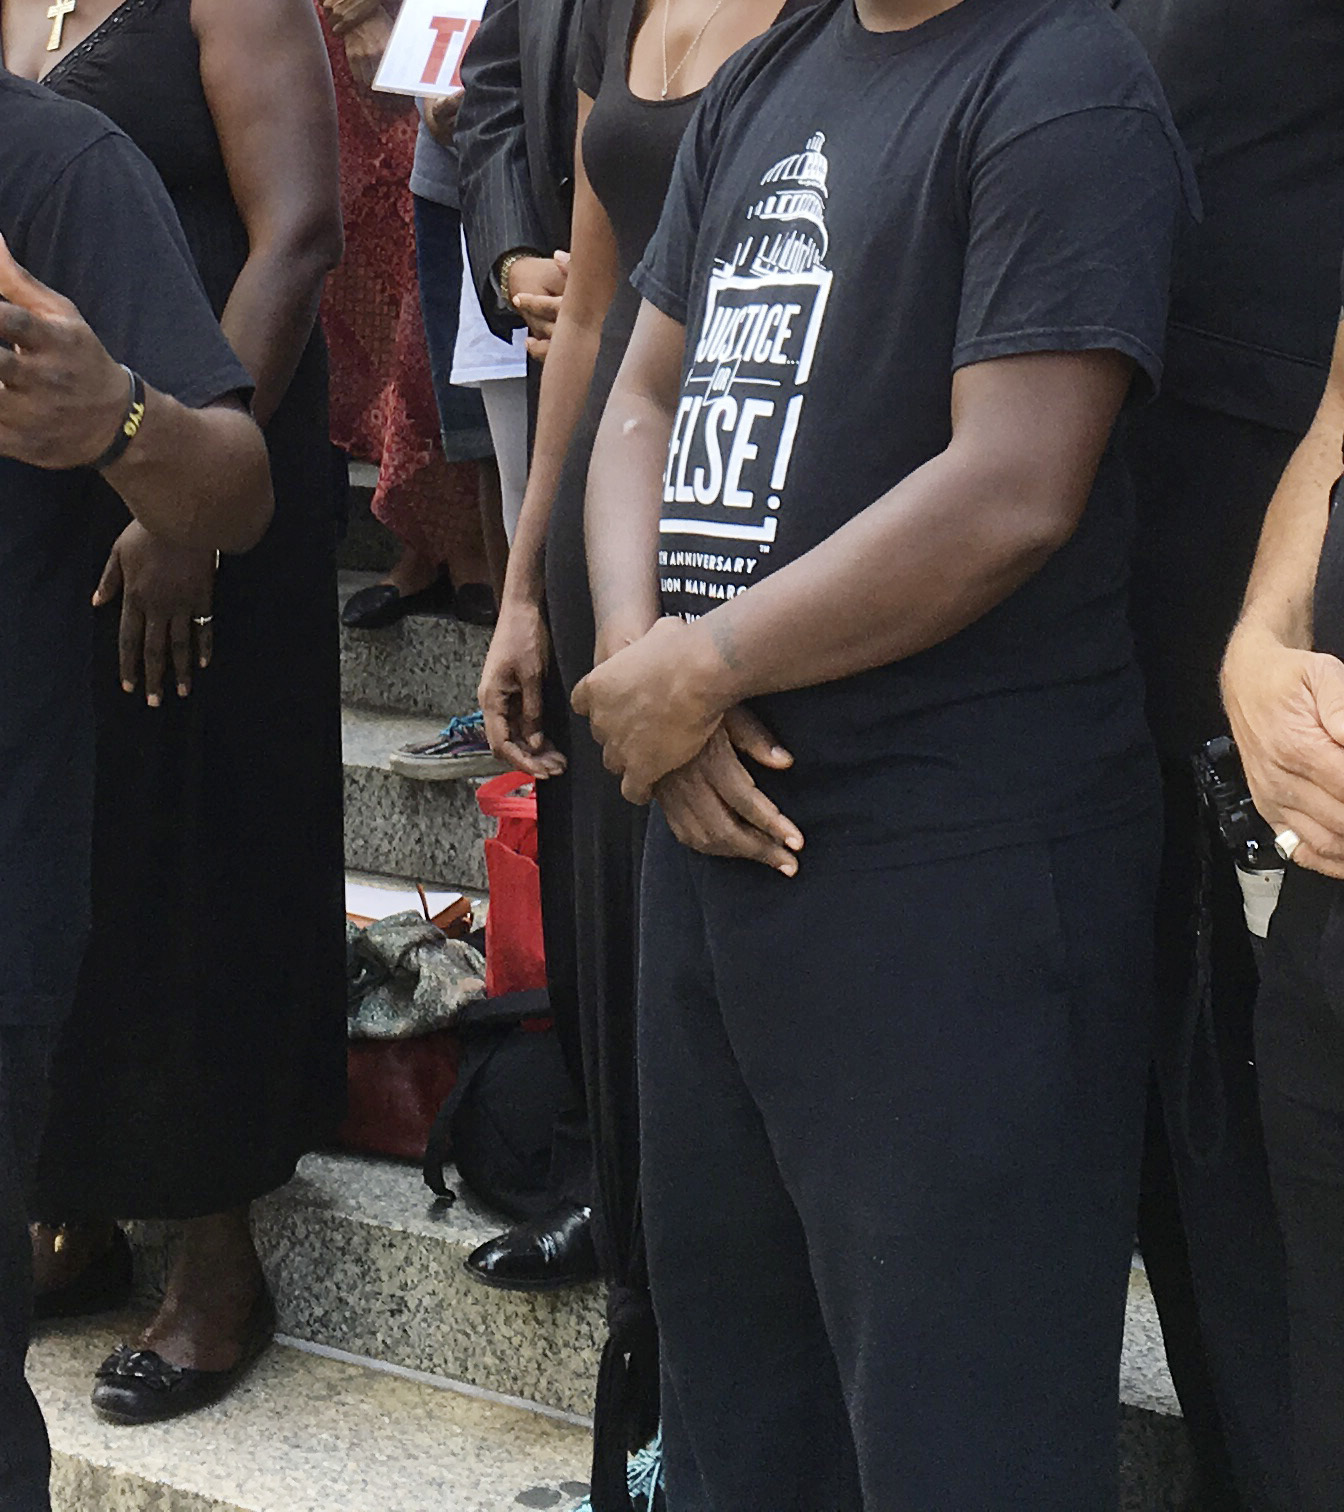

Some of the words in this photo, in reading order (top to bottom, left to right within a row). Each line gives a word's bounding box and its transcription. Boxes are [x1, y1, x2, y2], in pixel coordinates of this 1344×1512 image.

[663, 392, 803, 510] ELSE!
[669, 551, 757, 574] ANNIVERSARY
[685, 579, 706, 596] MAN
